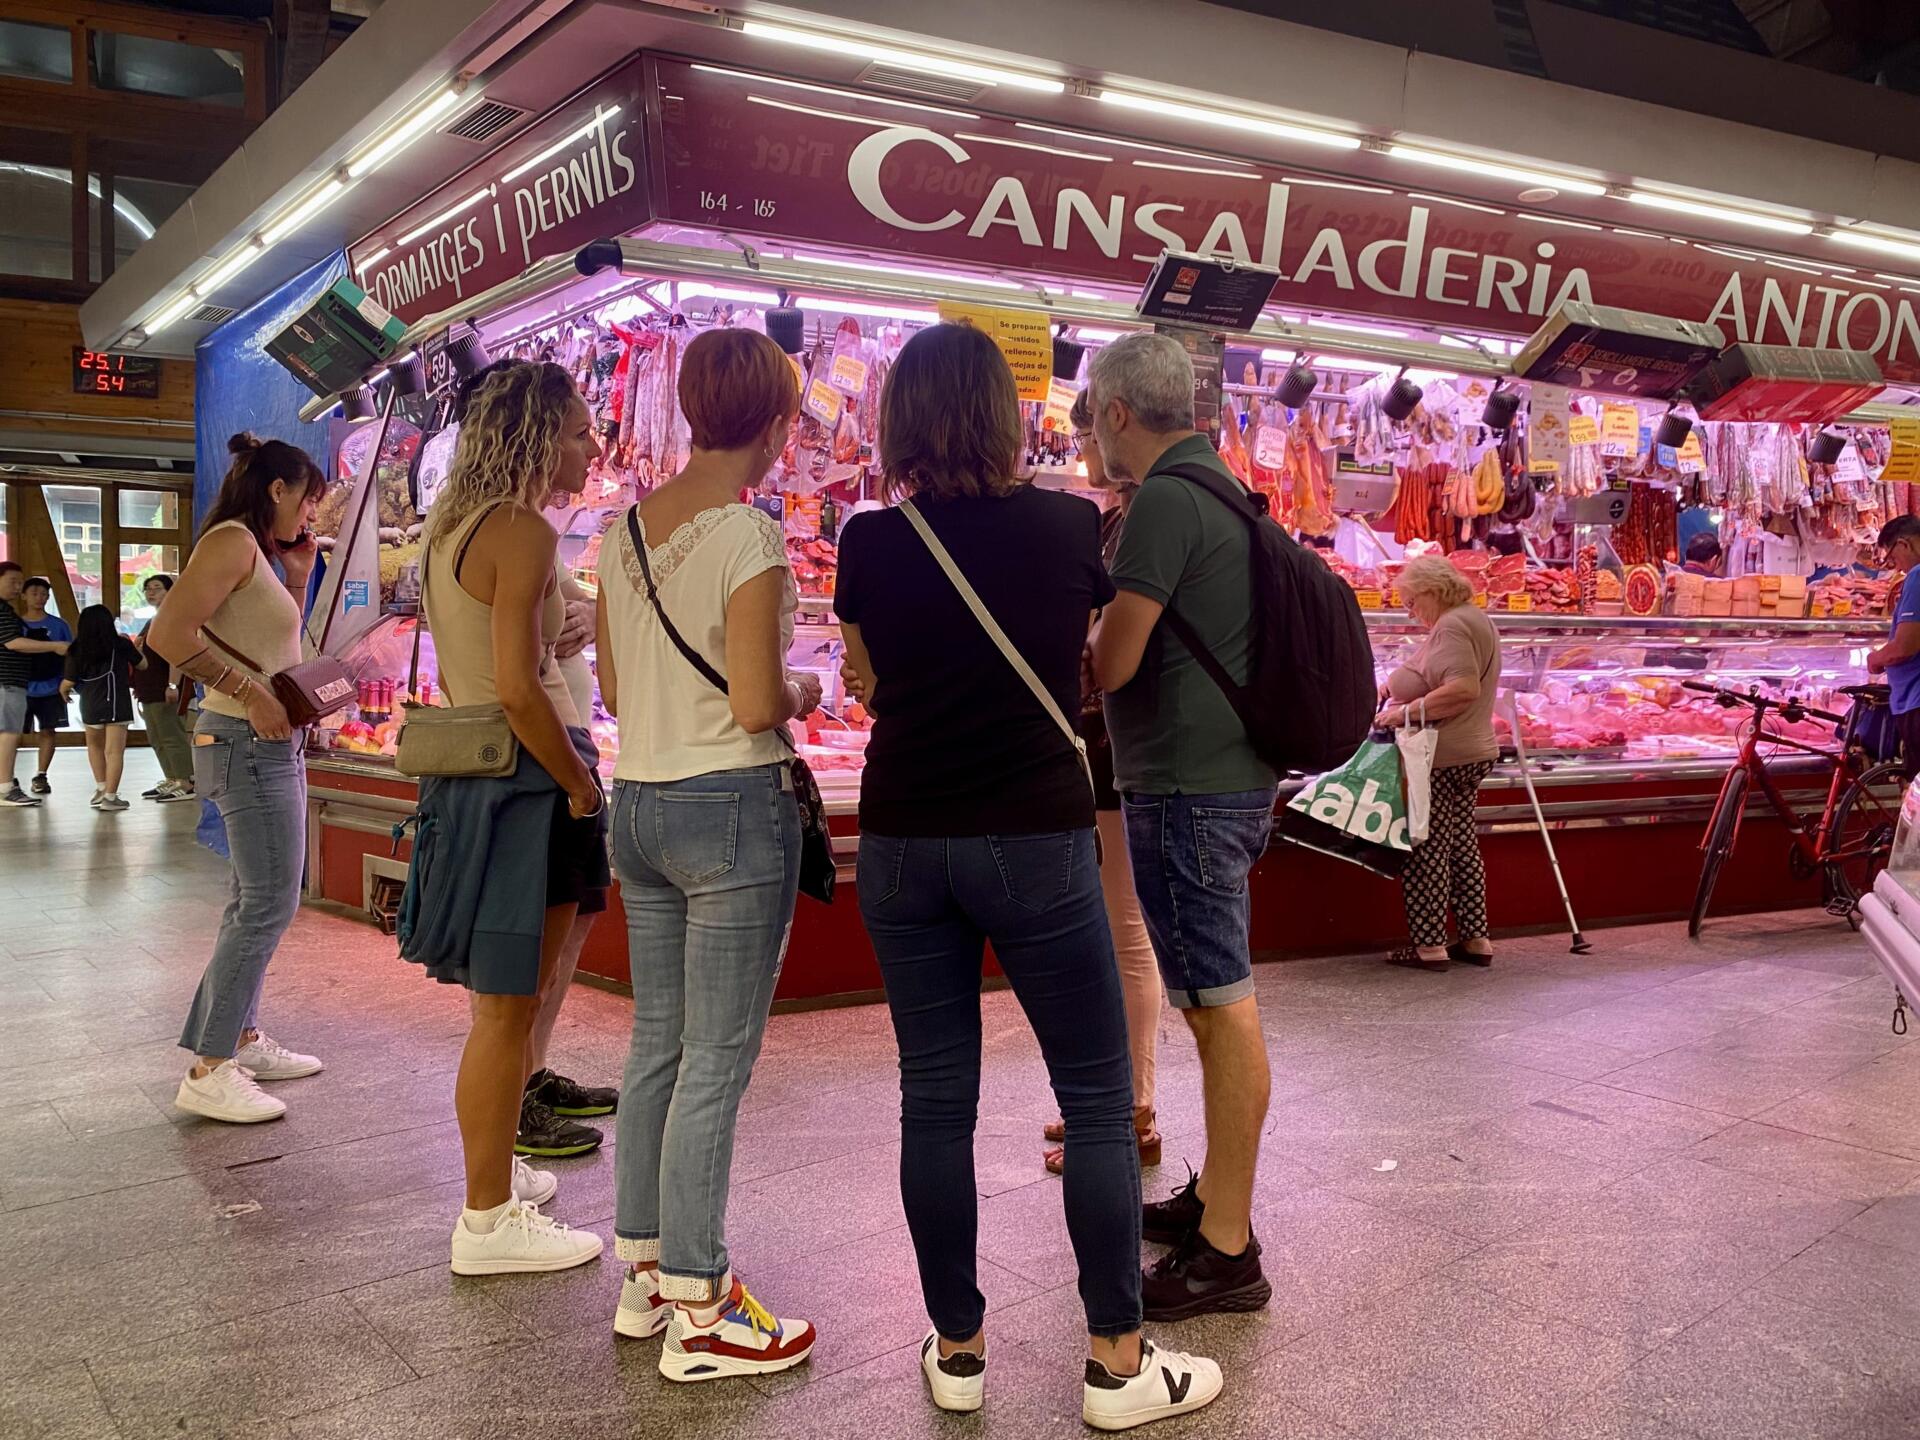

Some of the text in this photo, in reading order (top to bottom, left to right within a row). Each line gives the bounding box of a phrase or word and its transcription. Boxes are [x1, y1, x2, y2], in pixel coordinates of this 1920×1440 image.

[700, 191, 728, 212] 164
[754, 199, 776, 218] 165
[1000, 320, 1047, 331] Se preparan
[1005, 348, 1037, 356] rellenos
[1009, 361, 1048, 370] ndejas de
[1015, 374, 1041, 382] butido
